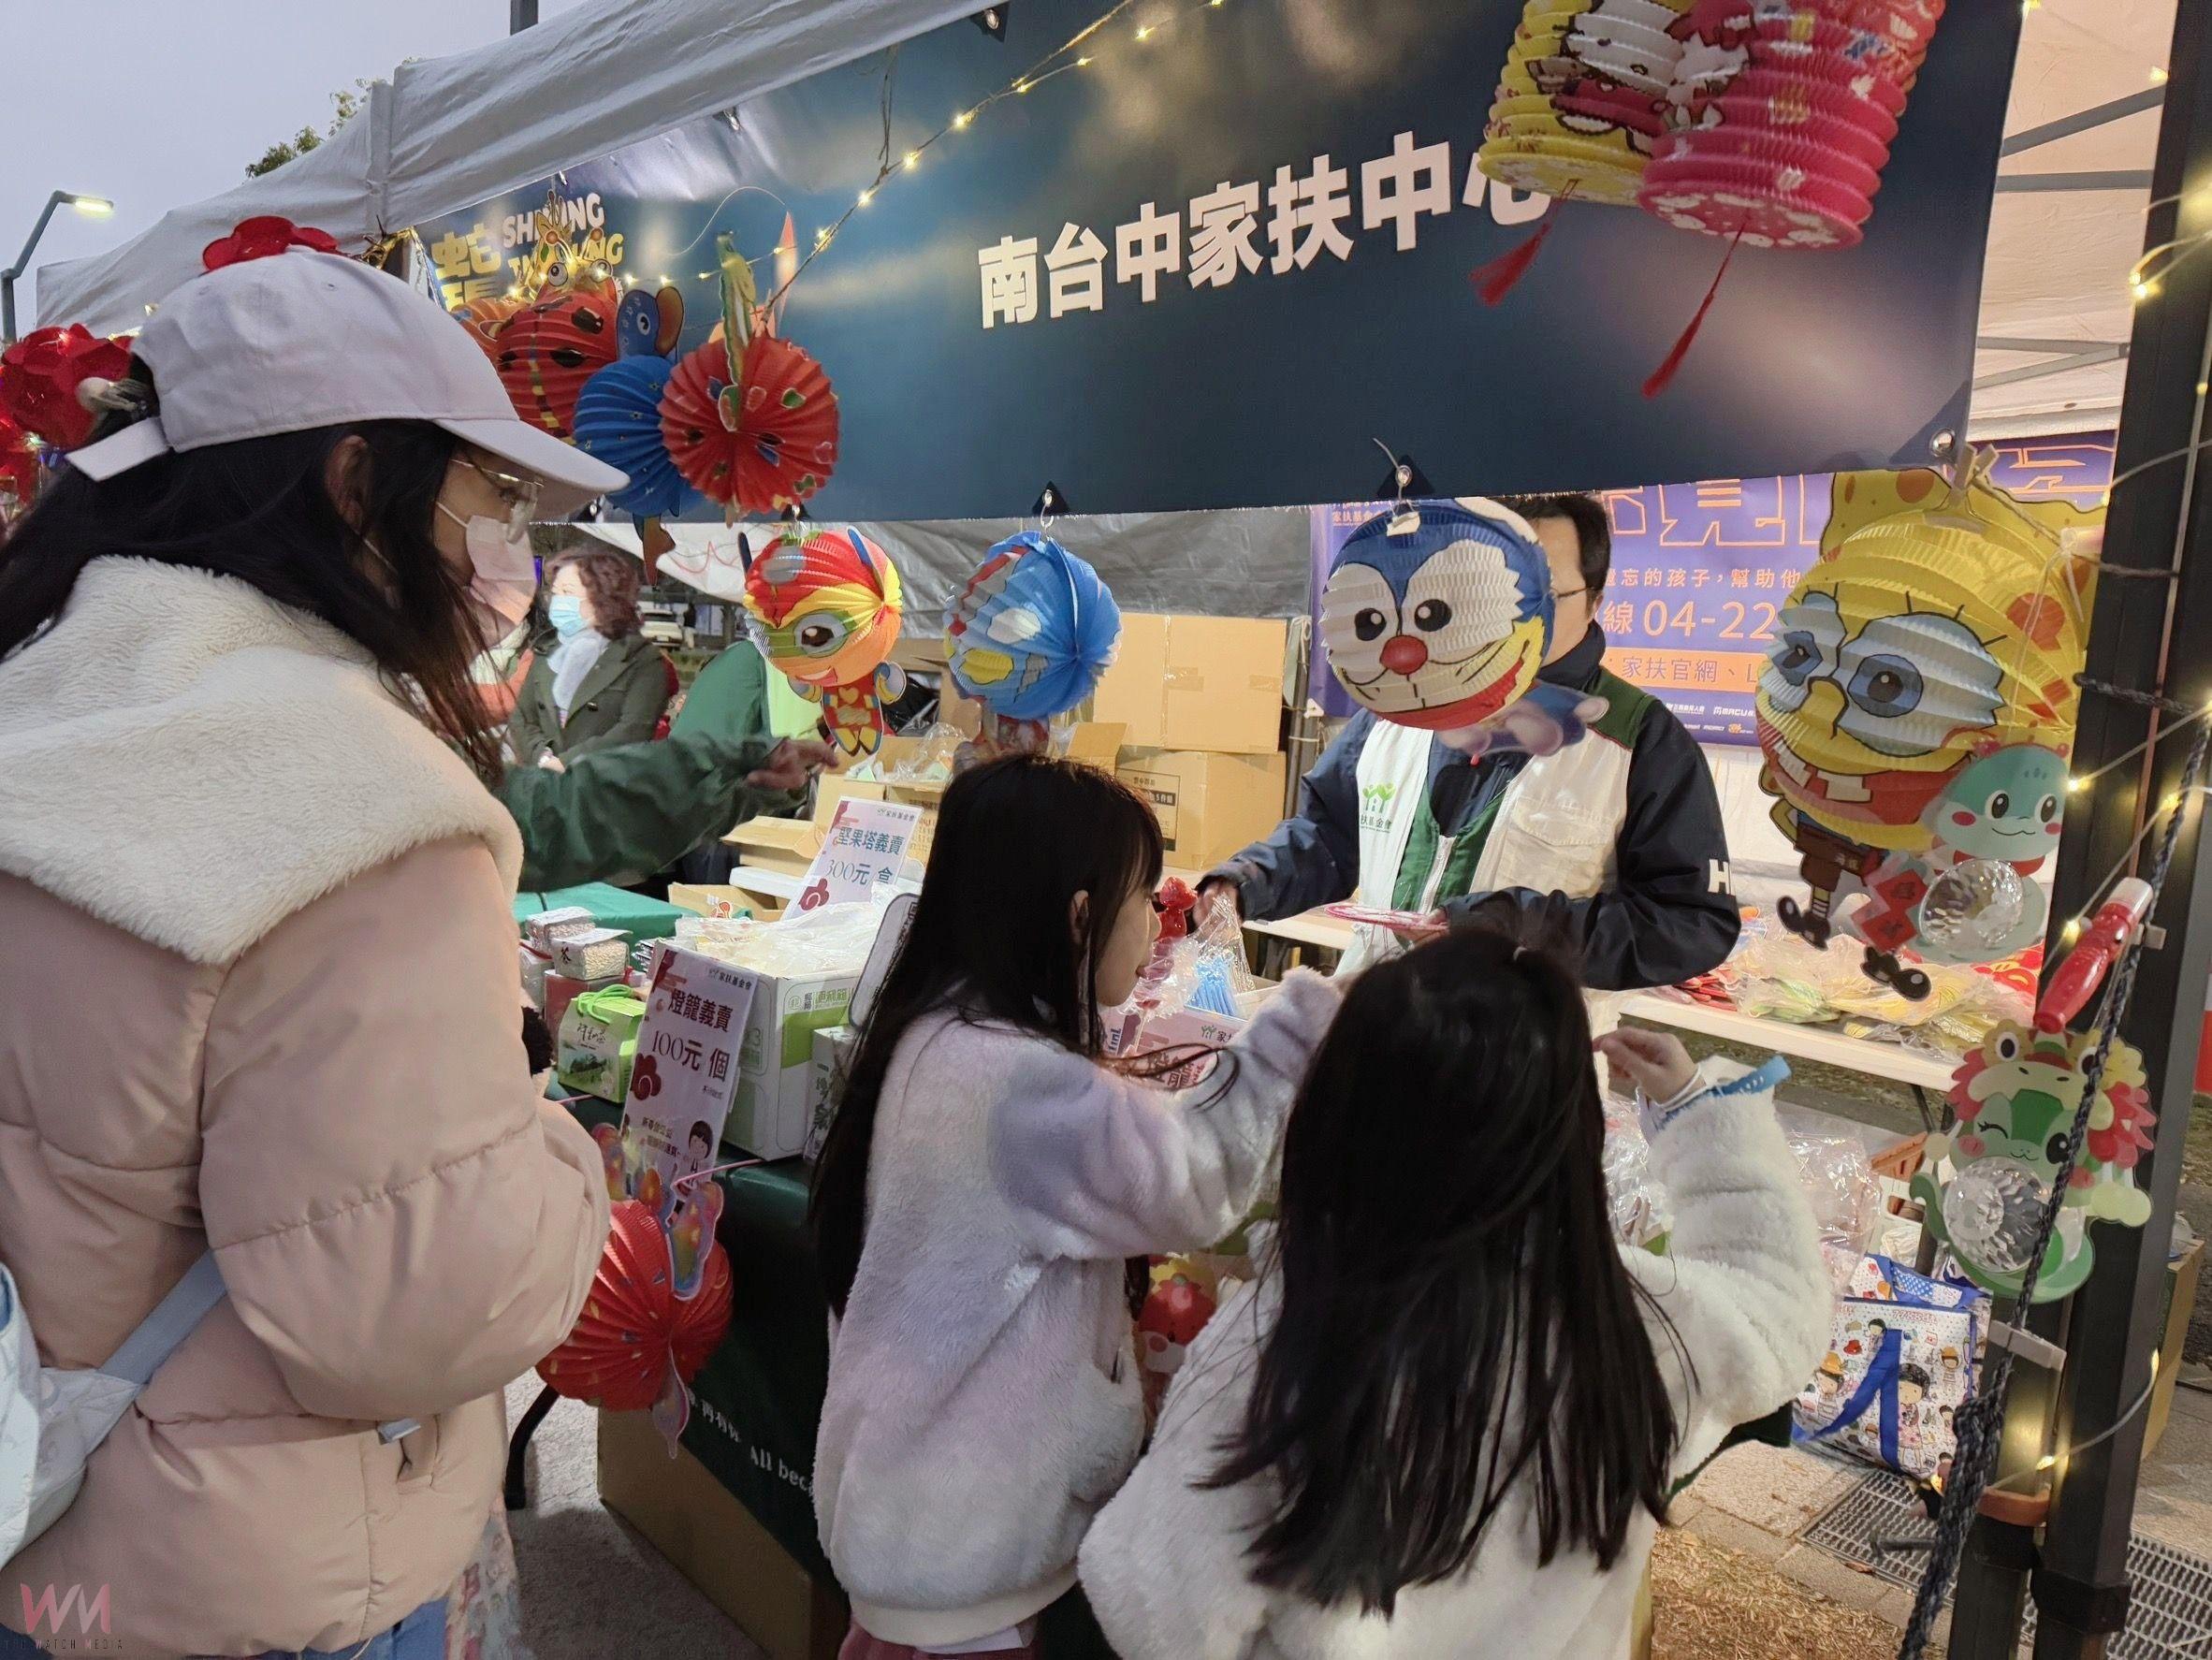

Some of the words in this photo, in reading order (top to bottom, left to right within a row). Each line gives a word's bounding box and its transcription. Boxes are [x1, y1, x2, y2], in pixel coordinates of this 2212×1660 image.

[1594, 600, 1634, 634] 線
[1643, 600, 1776, 640] 04-22
[836, 826, 905, 855] 堅果塔義賣
[1708, 858, 1736, 896] H
[668, 987, 734, 1032] 燈籠義賣
[652, 1030, 703, 1071] 100元
[708, 1048, 731, 1083] 個
[749, 1446, 773, 1471] All
